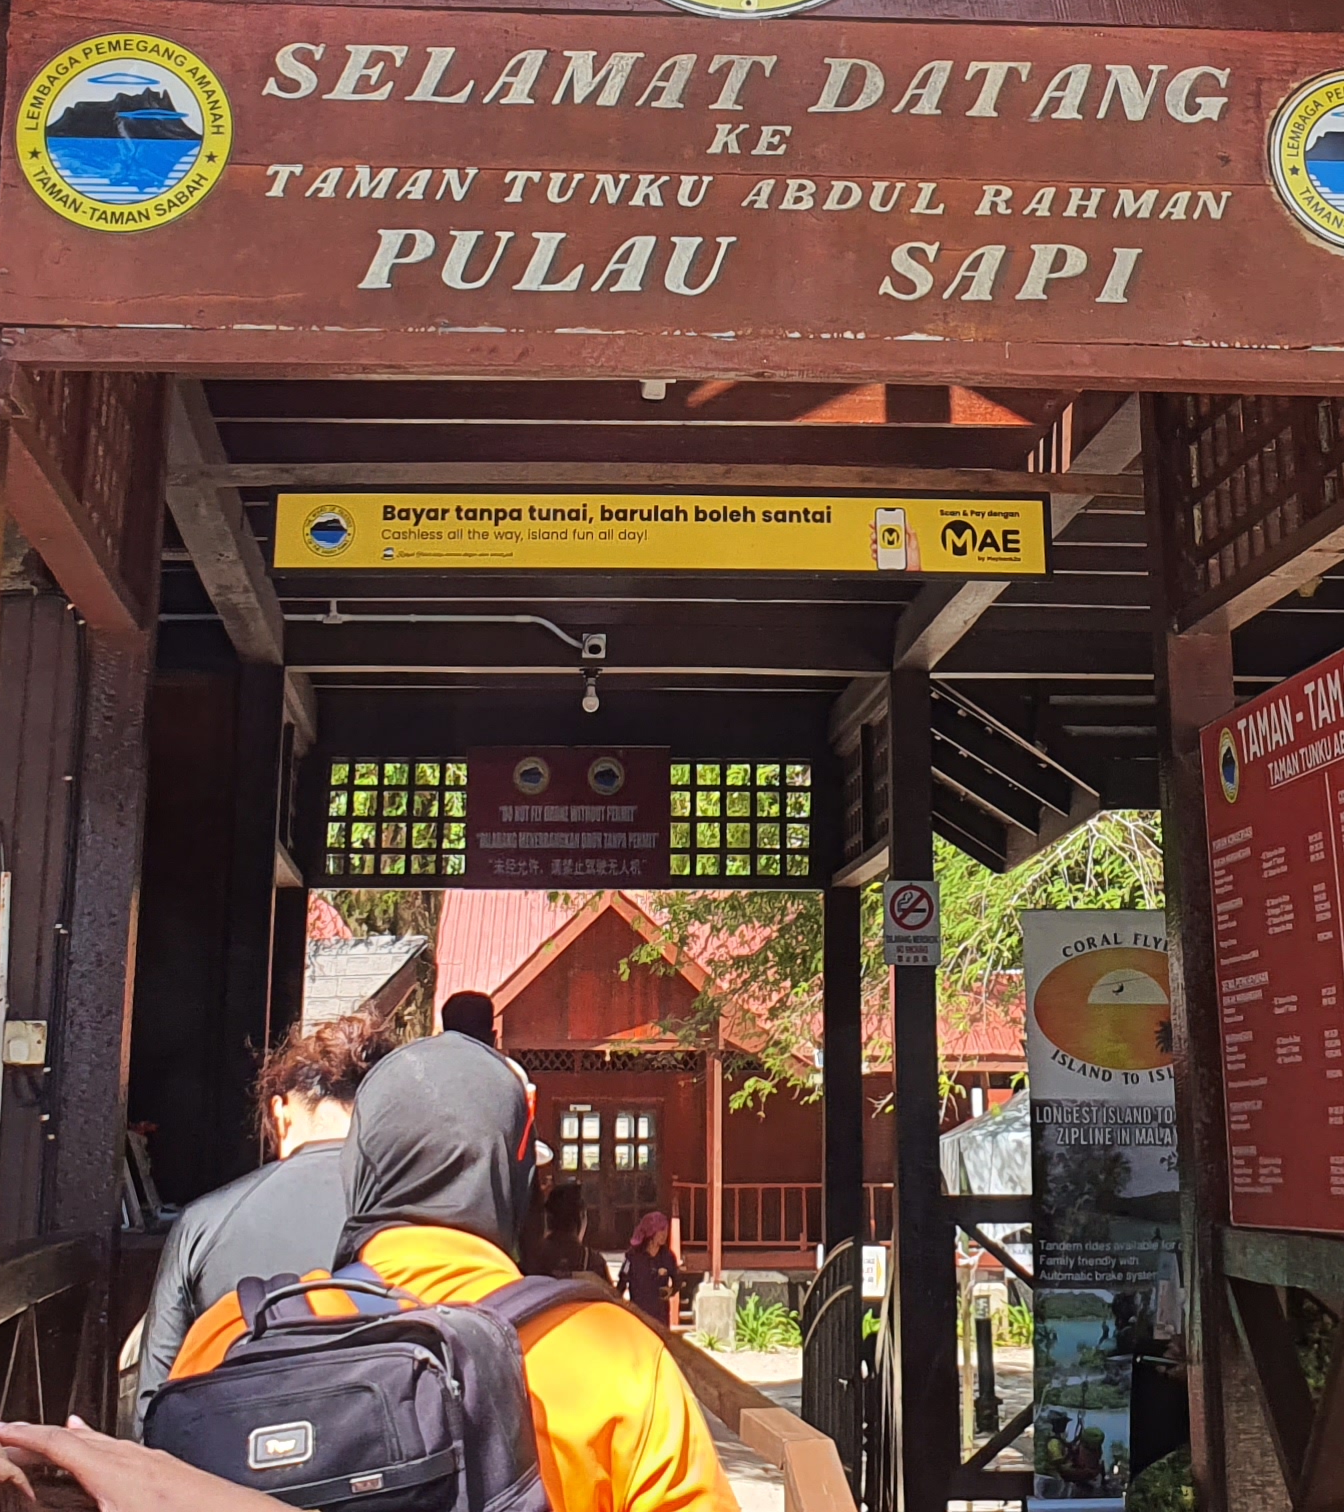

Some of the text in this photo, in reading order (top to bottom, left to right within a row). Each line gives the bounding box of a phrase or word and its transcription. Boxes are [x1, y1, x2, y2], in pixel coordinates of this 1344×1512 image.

[25, 38, 225, 136] LEMBAGA PEMEGANG AMANAH
[261, 42, 1232, 123] SELAMAT DATANG
[706, 124, 792, 156] KE
[1287, 99, 1324, 158] LEMBAGA
[31, 167, 209, 226] TAMAN-TAMAN SABAH
[266, 164, 1233, 222] TAMAN TUNKU ABDUL RAHMAN
[357, 229, 1143, 304] PULAU SAPI
[382, 504, 832, 526] Bayar tanpa tunai, barulah boleh santai
[970, 510, 986, 519] Pay
[381, 529, 648, 543] Cashless all the way, island fun all day!
[941, 520, 1021, 556] MAE
[1237, 695, 1295, 764] TAMAN
[1267, 754, 1300, 786] TAMAN
[1299, 735, 1333, 769] TUNKU
[1062, 932, 1123, 958] CORAL
[1050, 1049, 1175, 1085] ISLAND TO ISL
[1036, 1106, 1173, 1124] LONGEST ISLAND TO
[1056, 1126, 1173, 1145] ZIPLINE IN MALA
[1039, 1239, 1083, 1251] Tandem
[1085, 1240, 1111, 1251] rides
[1039, 1255, 1075, 1269] Family
[1077, 1255, 1117, 1269] friendly
[1039, 1270, 1093, 1281] Automatic
[1094, 1270, 1123, 1281] brake
